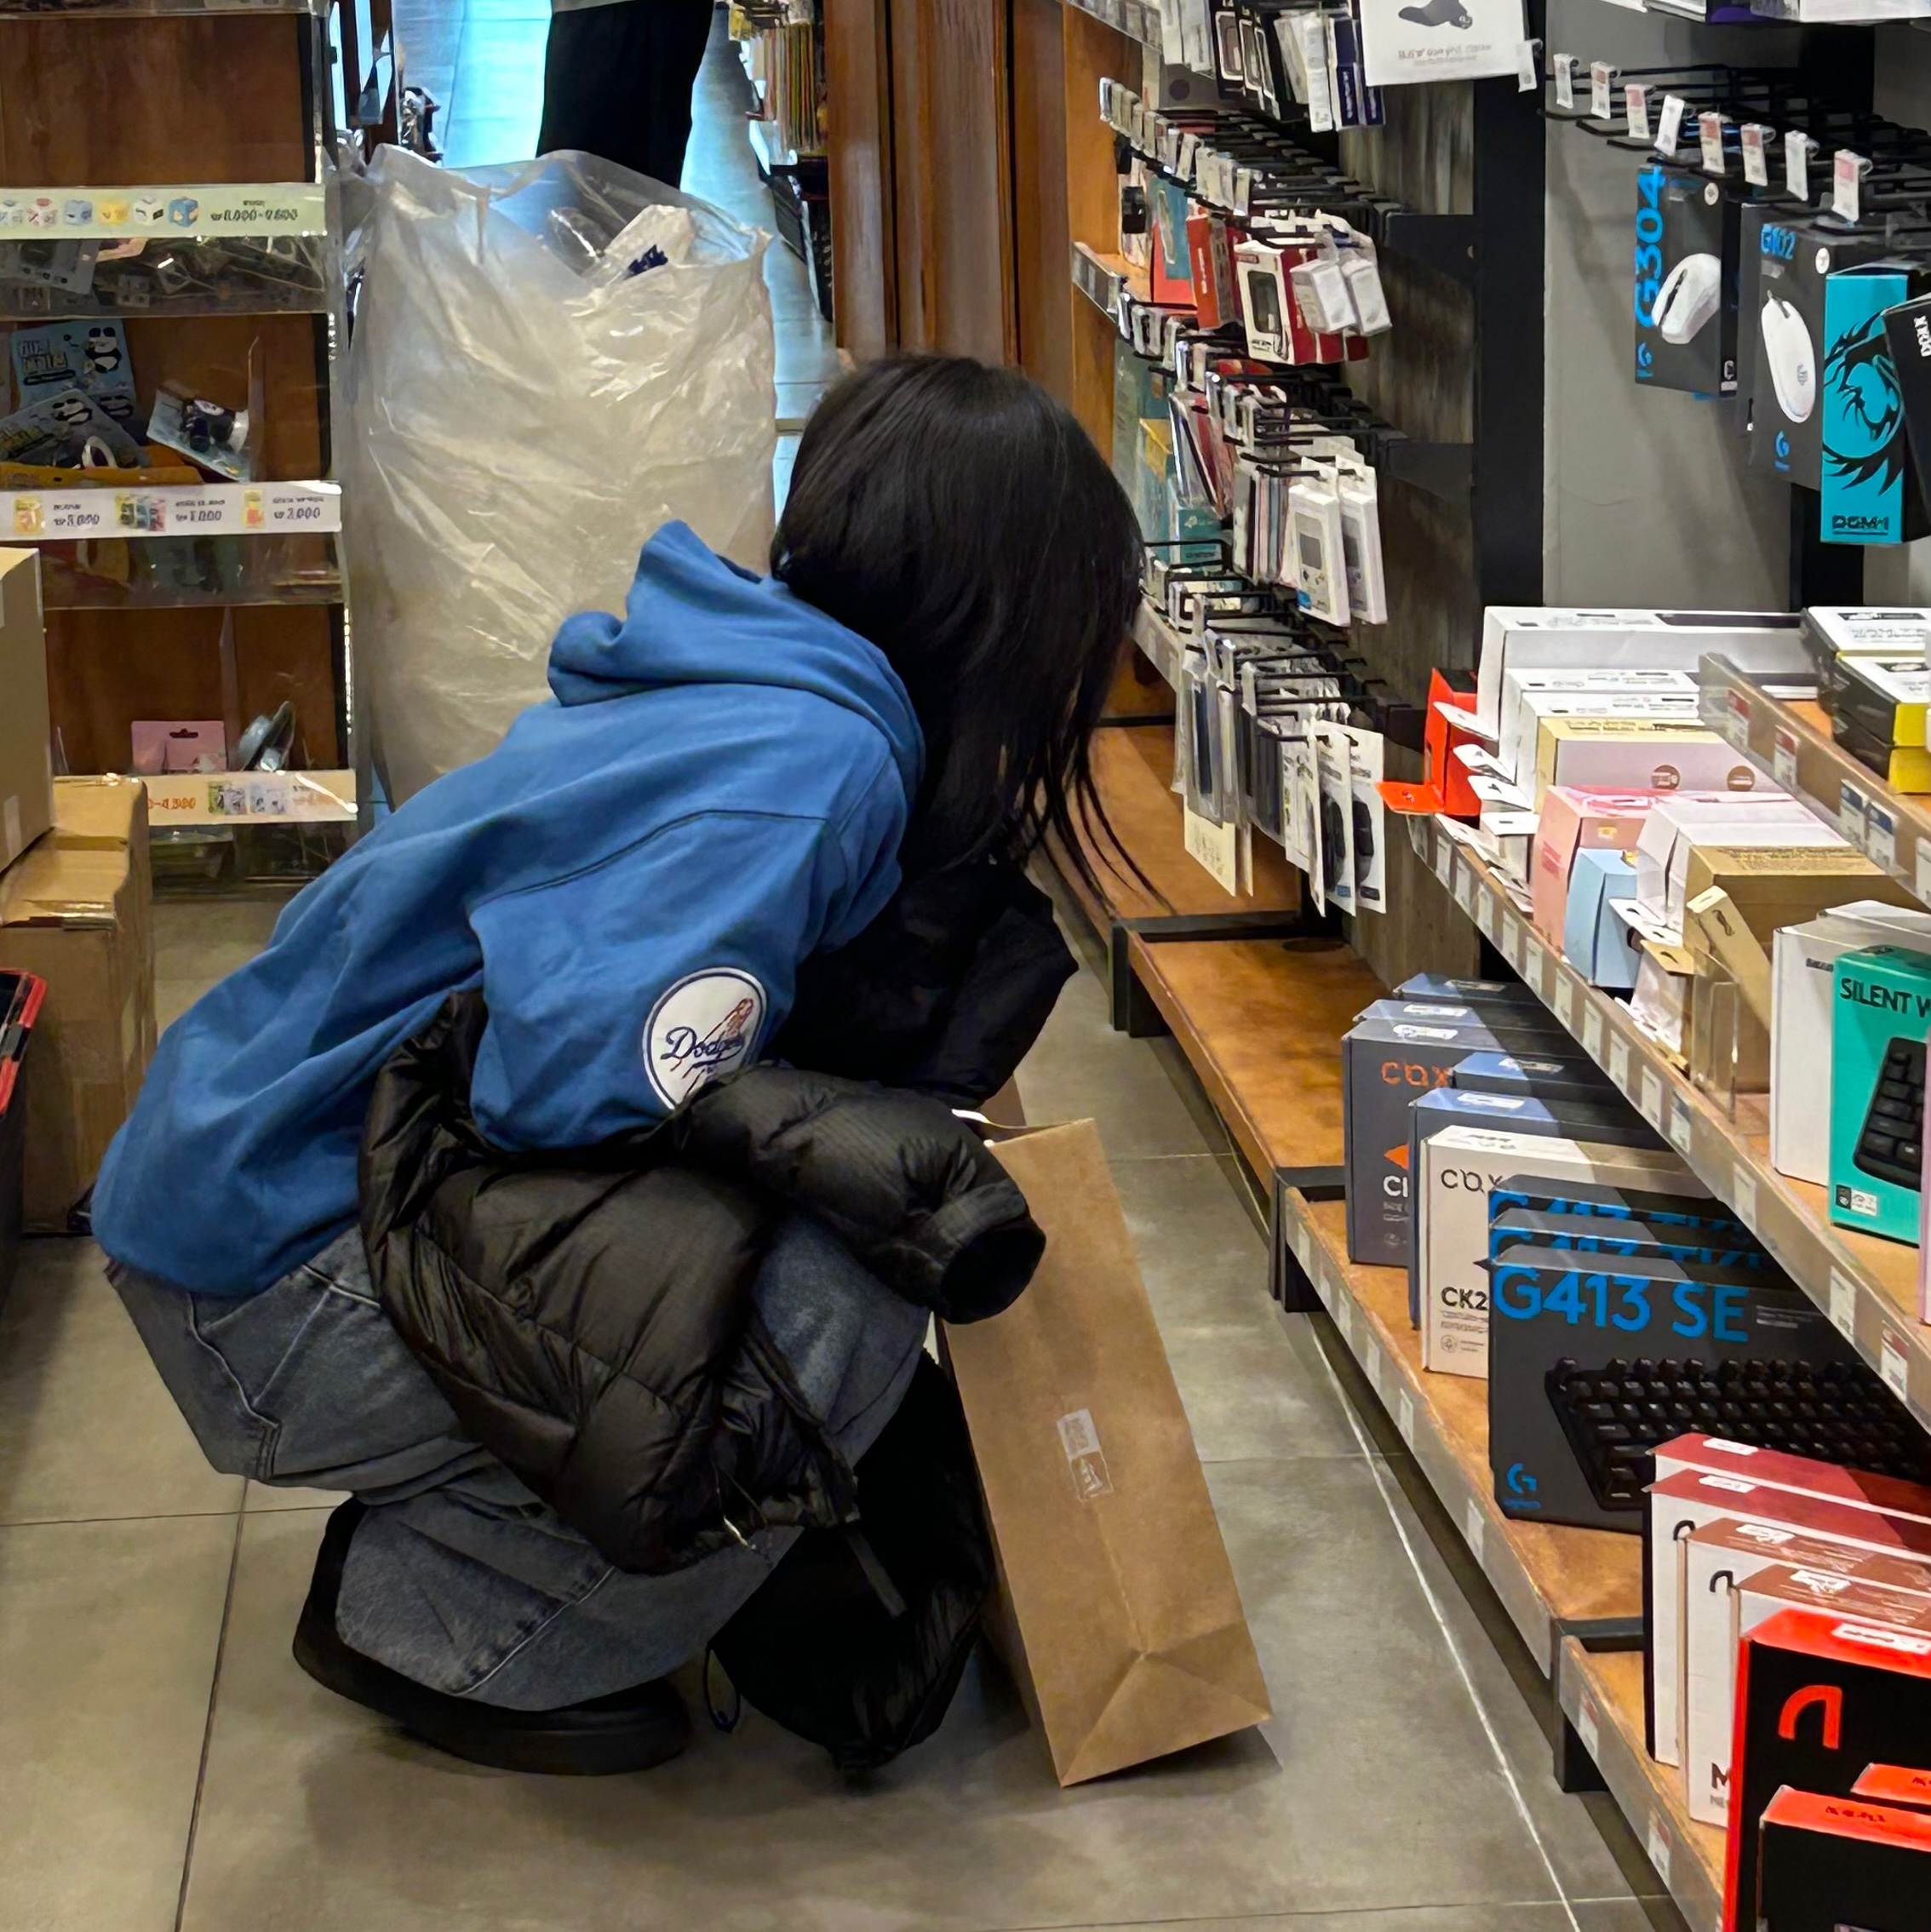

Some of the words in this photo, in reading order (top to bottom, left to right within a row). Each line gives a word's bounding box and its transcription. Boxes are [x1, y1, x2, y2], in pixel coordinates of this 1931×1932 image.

[1634, 166, 1665, 329] G304
[1839, 977, 1913, 1015] SILENT
[1493, 1266, 1653, 1333] G413
[1671, 1281, 1750, 1344] SE
